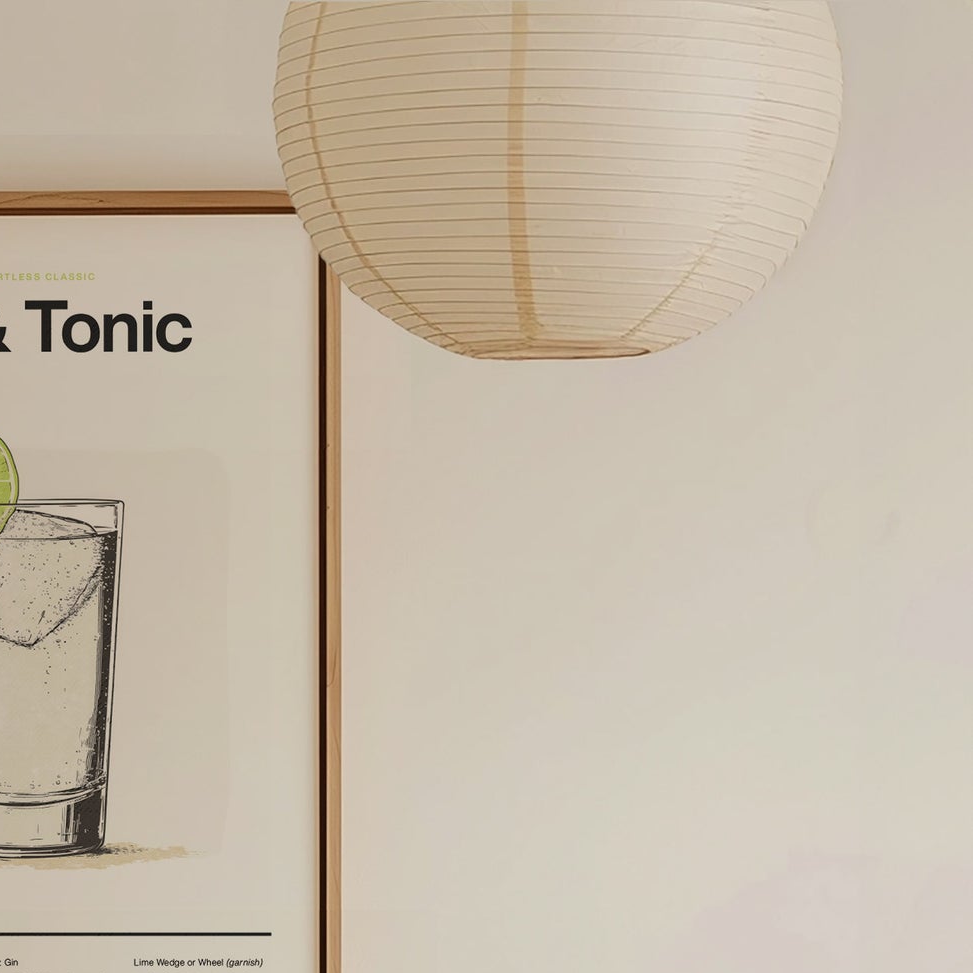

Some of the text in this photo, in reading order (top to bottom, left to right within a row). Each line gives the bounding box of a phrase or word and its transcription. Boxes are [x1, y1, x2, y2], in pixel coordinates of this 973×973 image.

[44, 271, 97, 282] CLASSIC
[24, 299, 193, 354] Tonic
[3, 957, 19, 967] Gin
[133, 957, 265, 969] Lime Wedge or Wheel (garnish)
